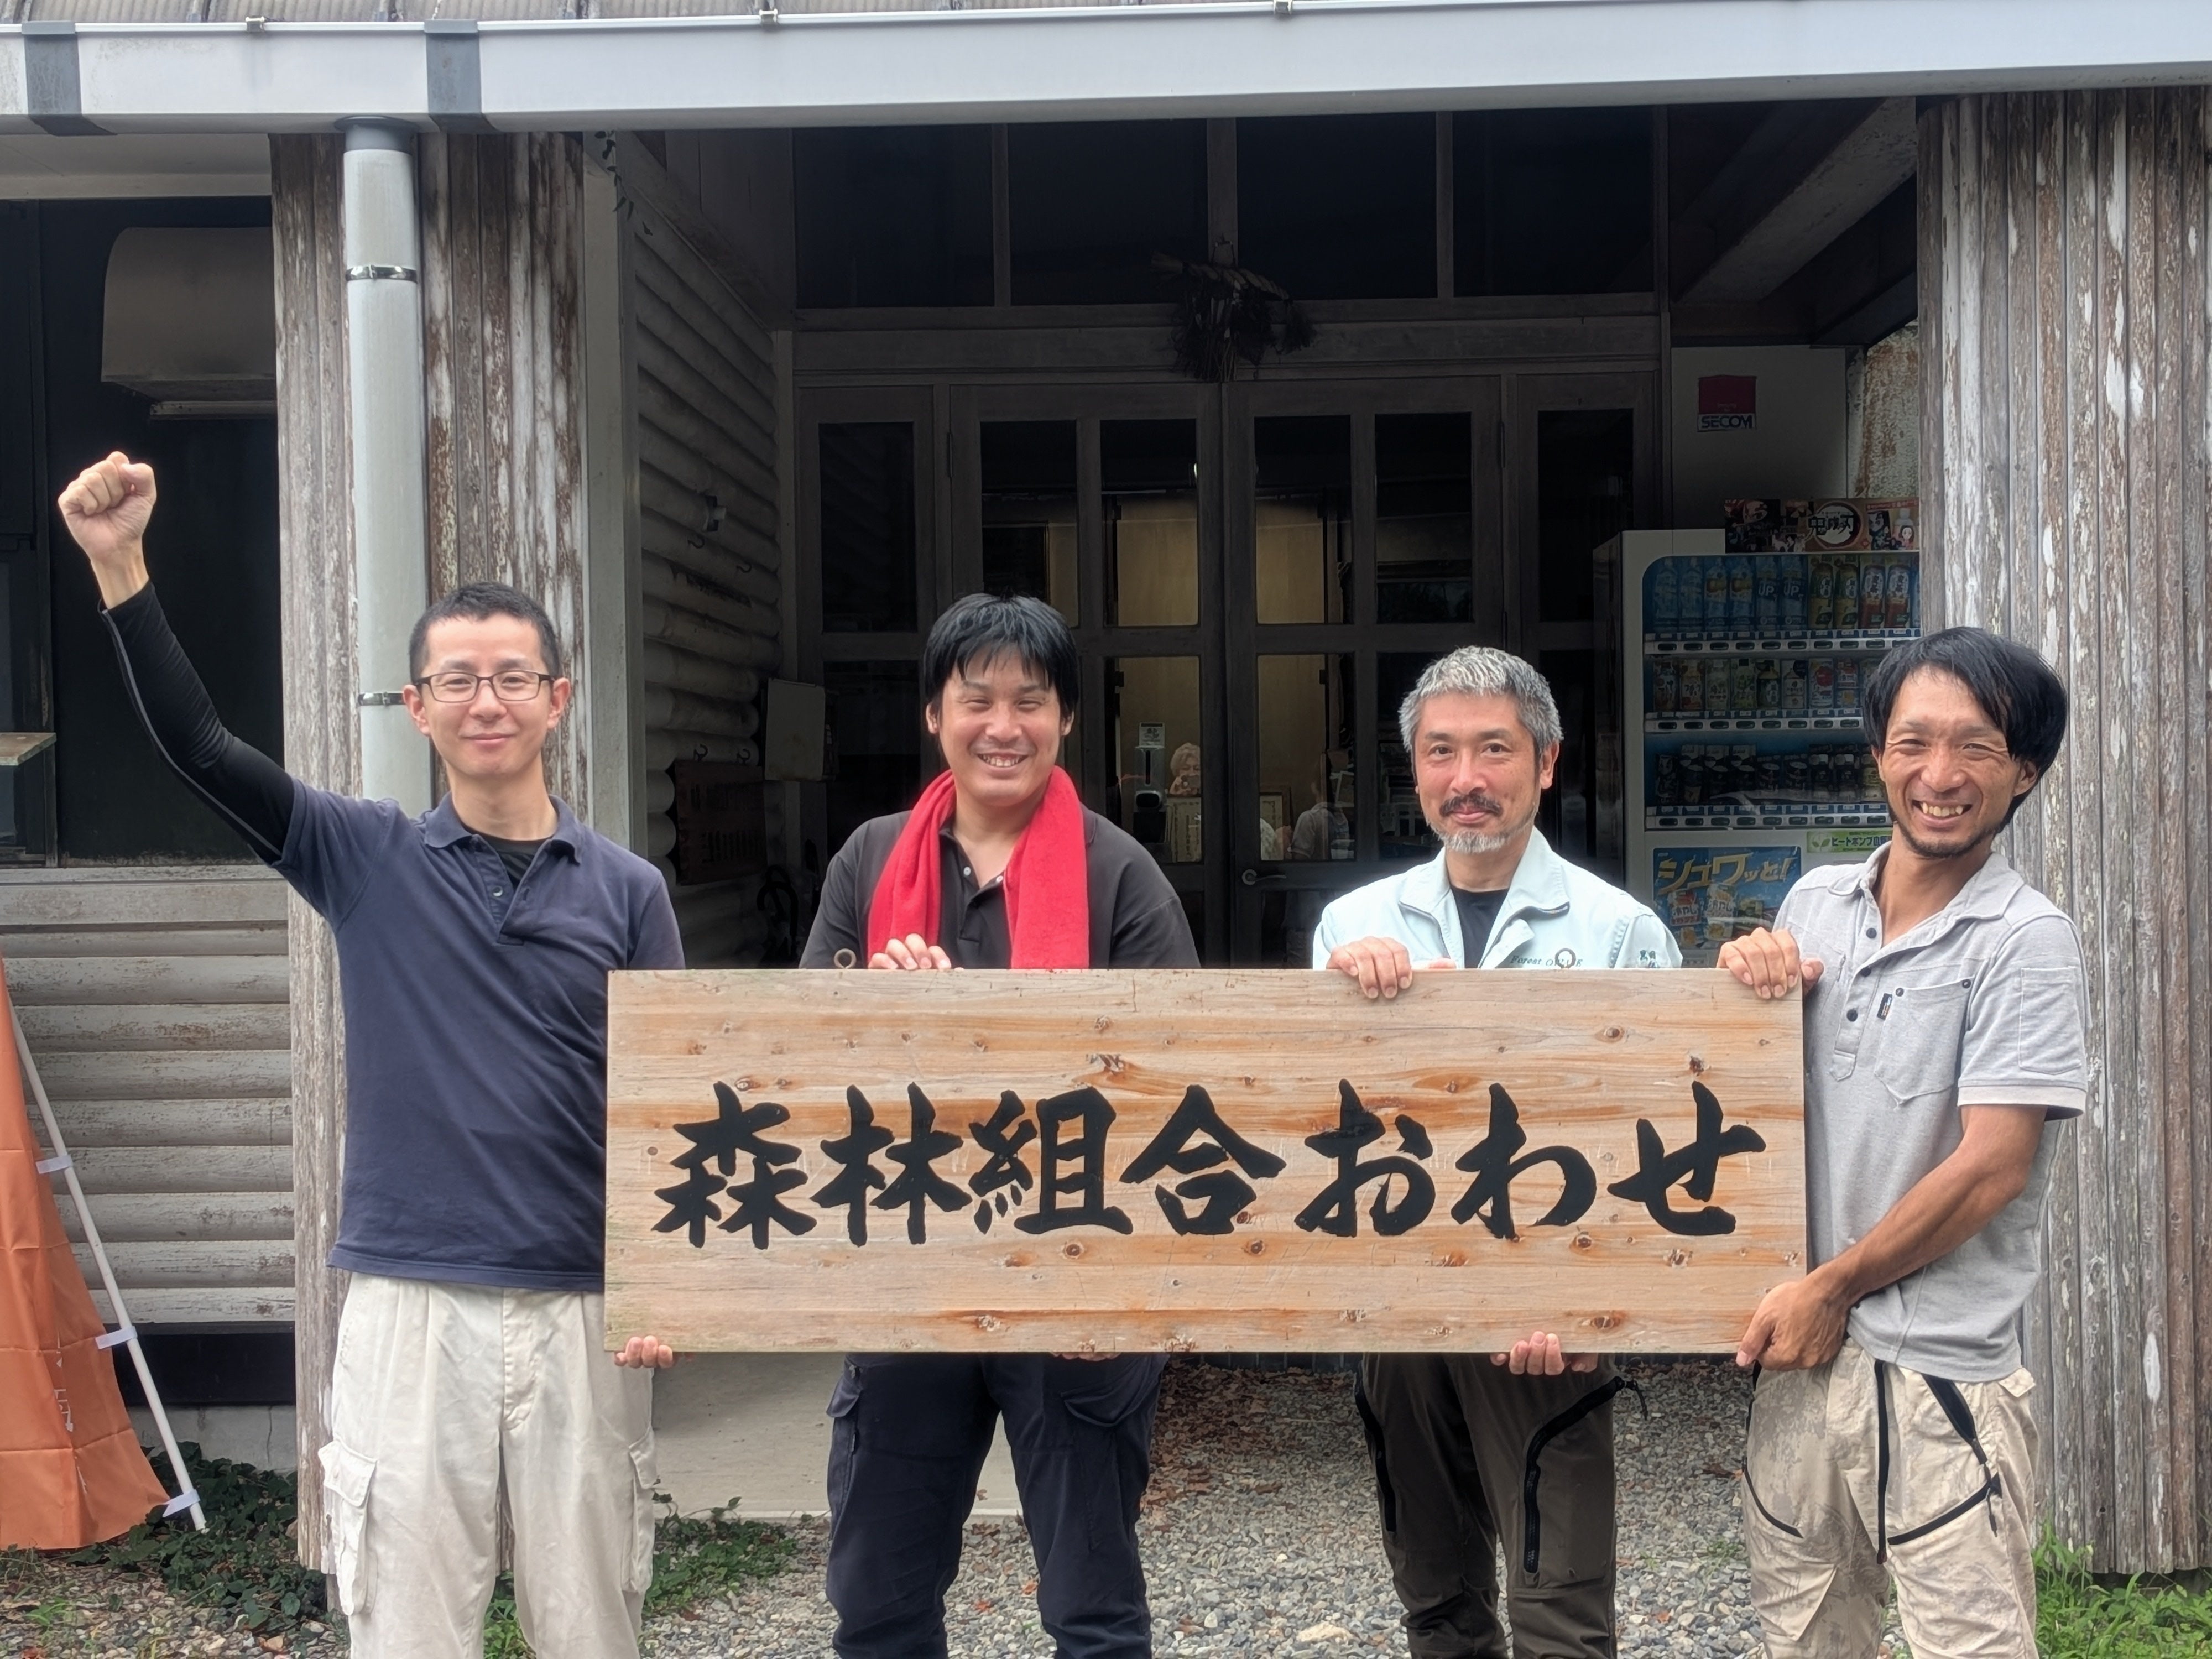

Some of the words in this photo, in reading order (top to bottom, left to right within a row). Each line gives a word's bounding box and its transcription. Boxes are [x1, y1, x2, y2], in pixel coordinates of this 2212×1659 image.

[1701, 415, 1752, 429] SECOM
[1510, 955, 1542, 965] Forest
[651, 1079, 1766, 1250] 森林組合おわせ
